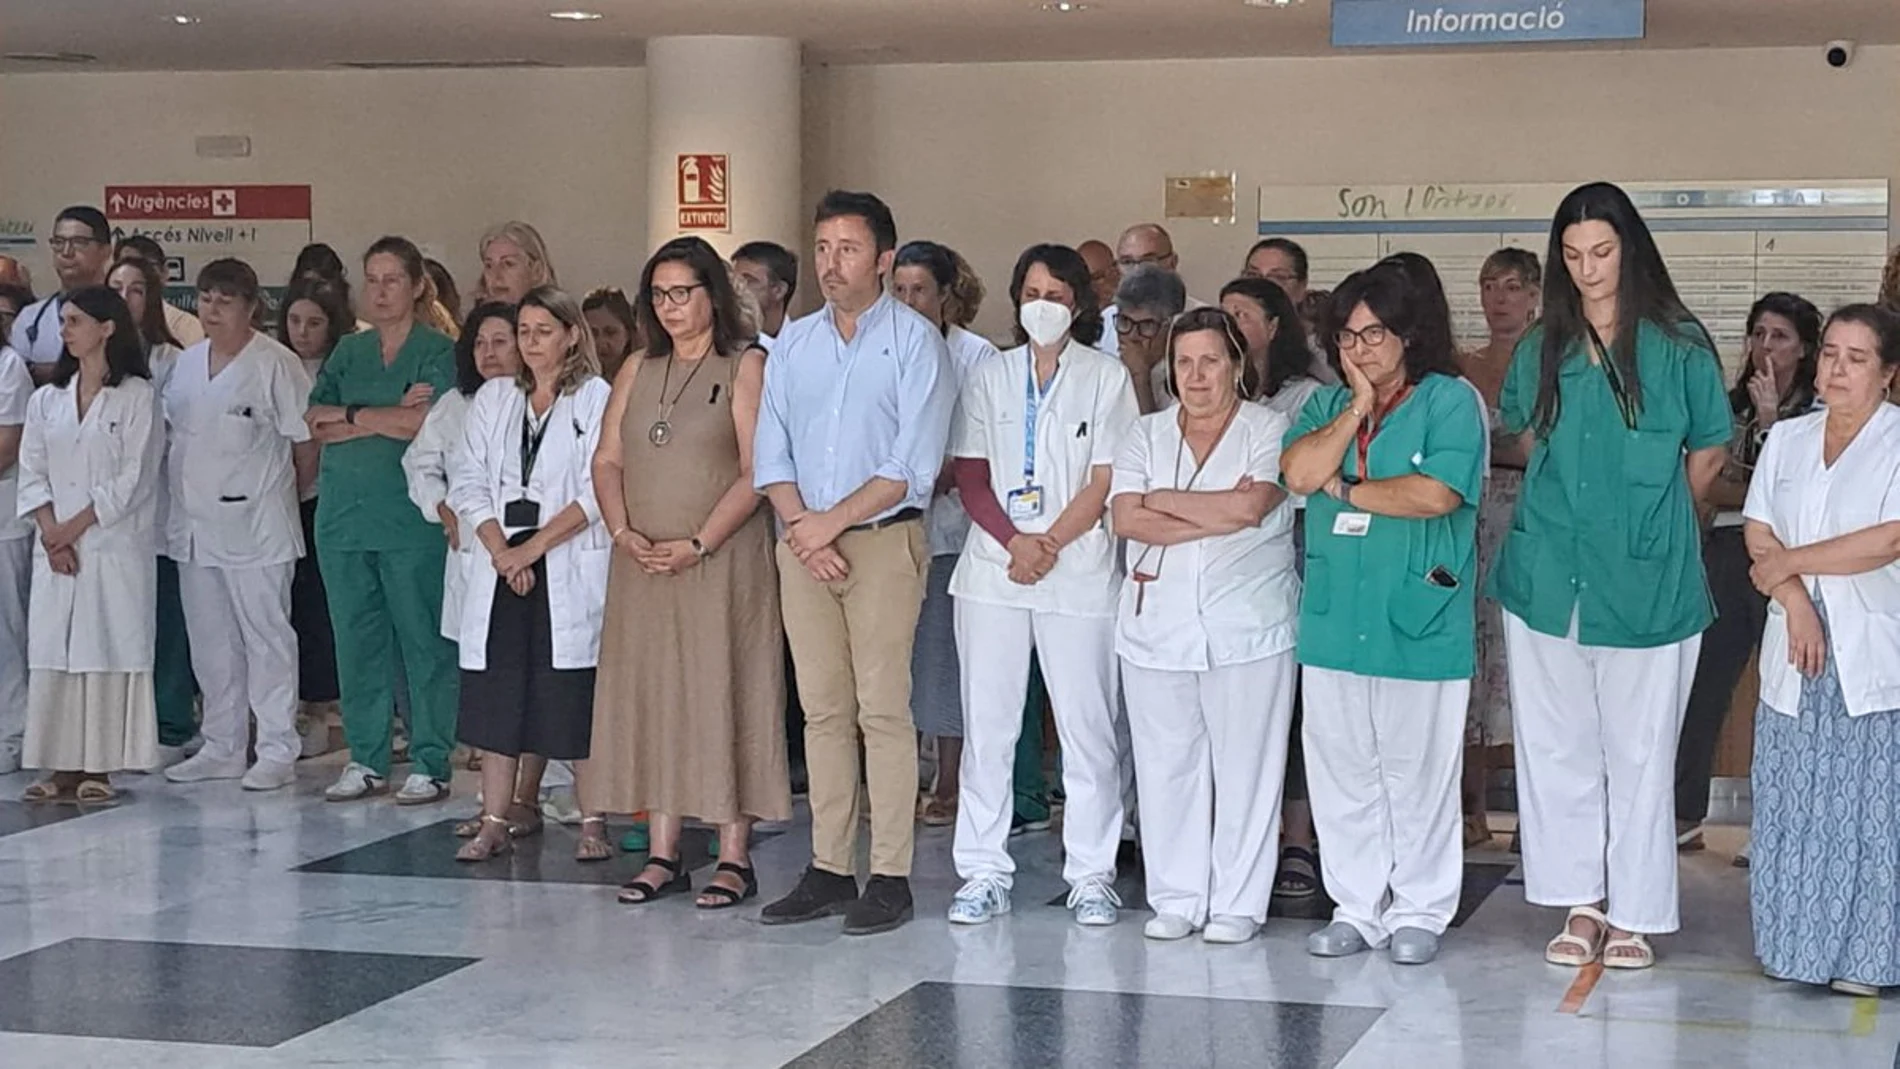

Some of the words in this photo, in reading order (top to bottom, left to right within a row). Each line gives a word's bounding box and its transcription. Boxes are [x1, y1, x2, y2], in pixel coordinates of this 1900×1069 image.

[1406, 2, 1564, 33] Informació
[127, 191, 210, 213] Urgències
[1337, 187, 1388, 219] Son
[680, 211, 725, 225] EXTINTOR
[188, 227, 234, 242] Nivell
